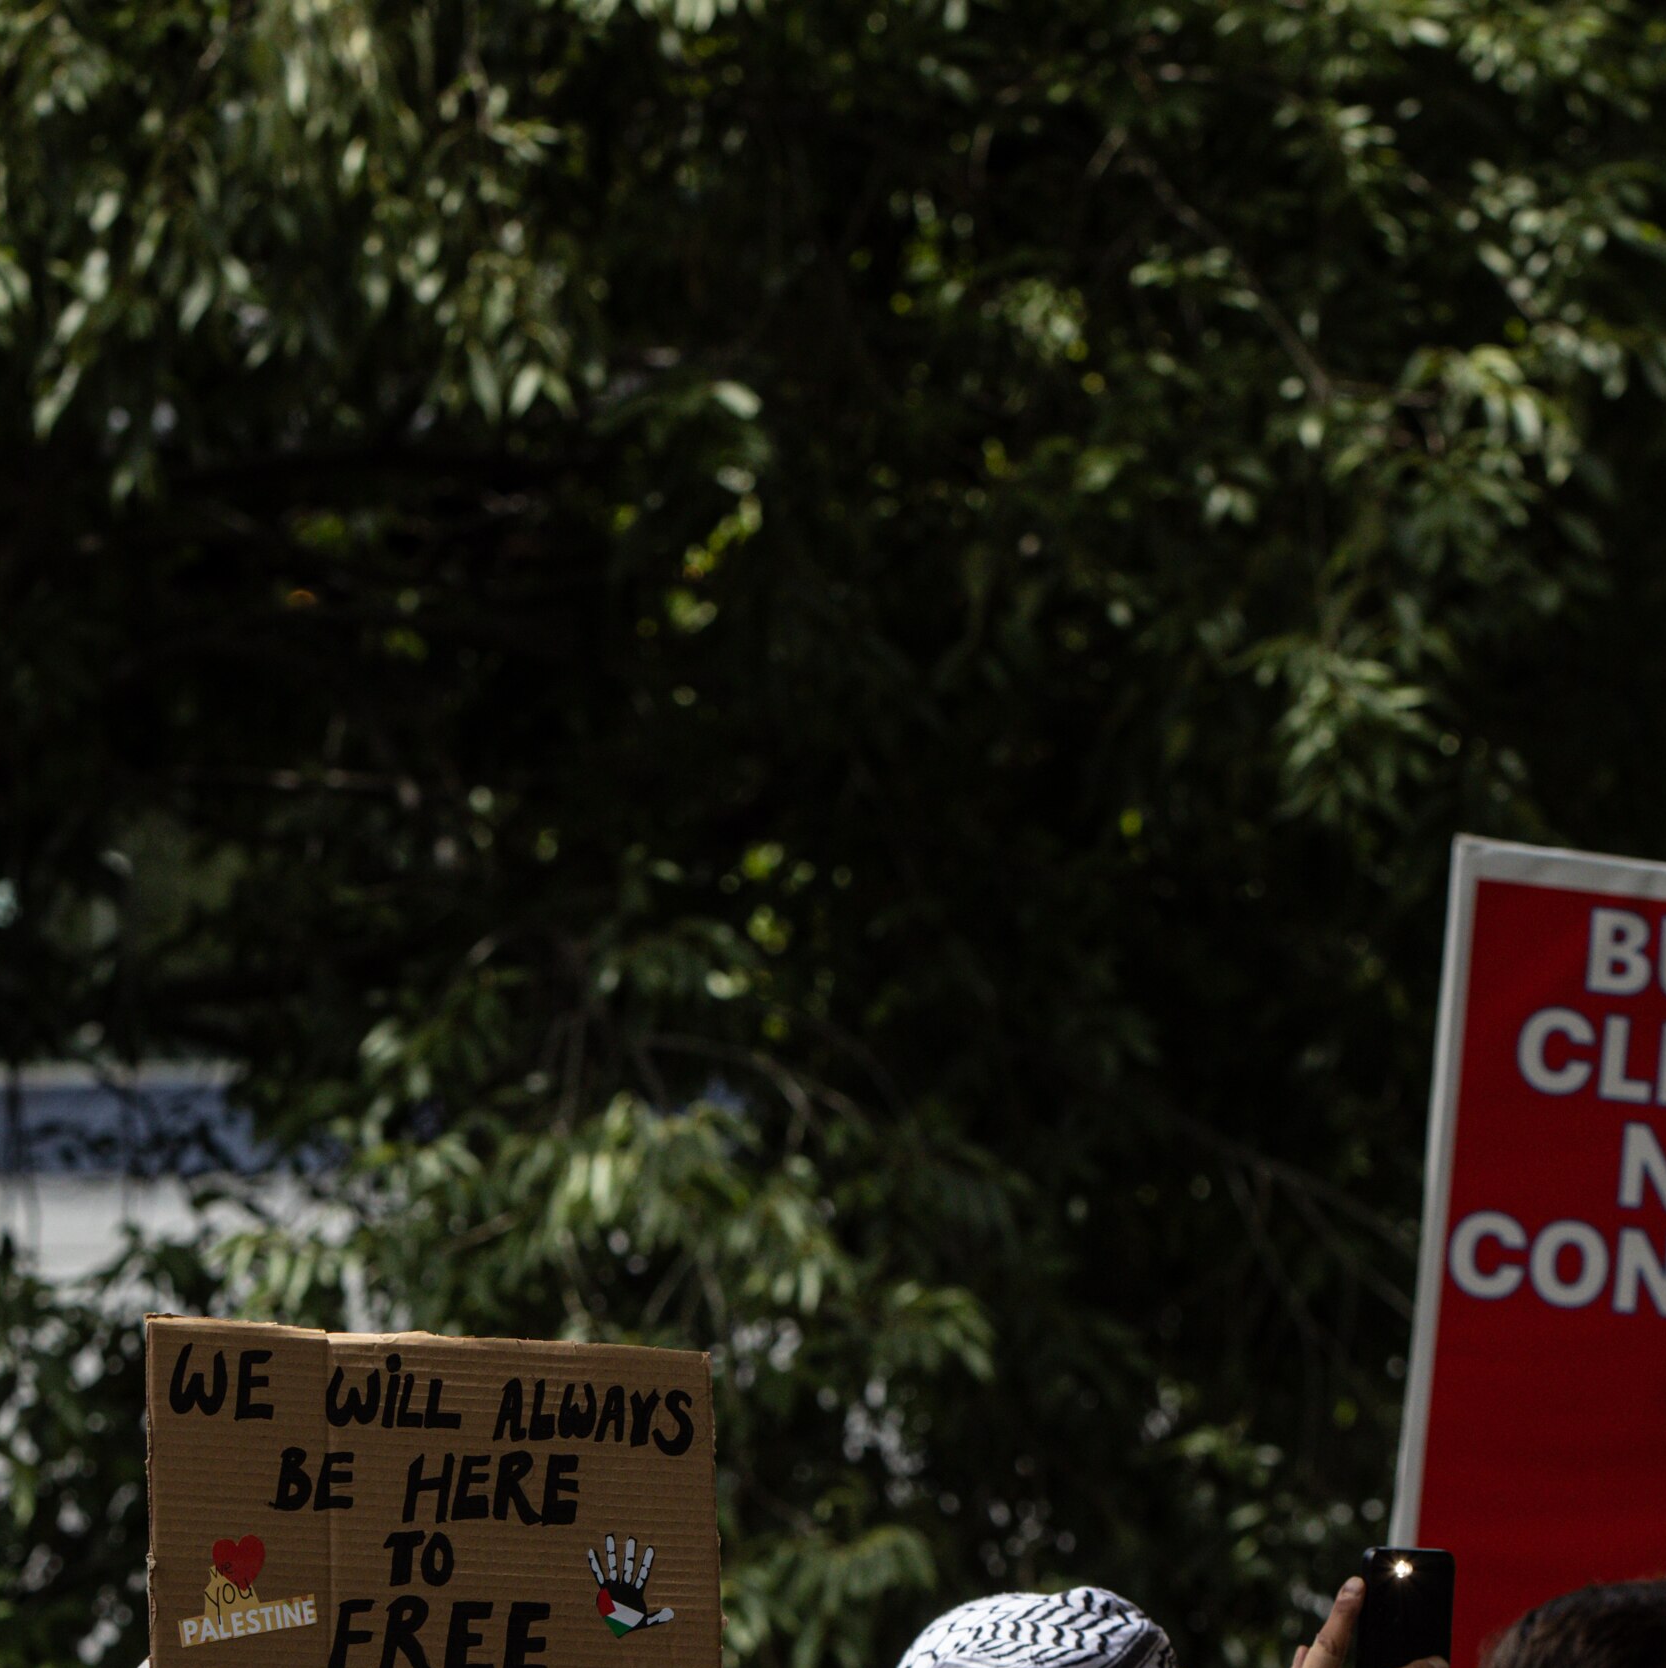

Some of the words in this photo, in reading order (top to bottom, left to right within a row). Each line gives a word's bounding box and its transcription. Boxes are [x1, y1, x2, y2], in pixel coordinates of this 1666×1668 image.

[169, 1342, 274, 1421] WE
[493, 1377, 695, 1456] ALWAYS
[267, 1446, 355, 1511] BE
[402, 1450, 581, 1526] HERE
[383, 1530, 454, 1587] TO
[183, 1600, 316, 1644] PALESTINE
